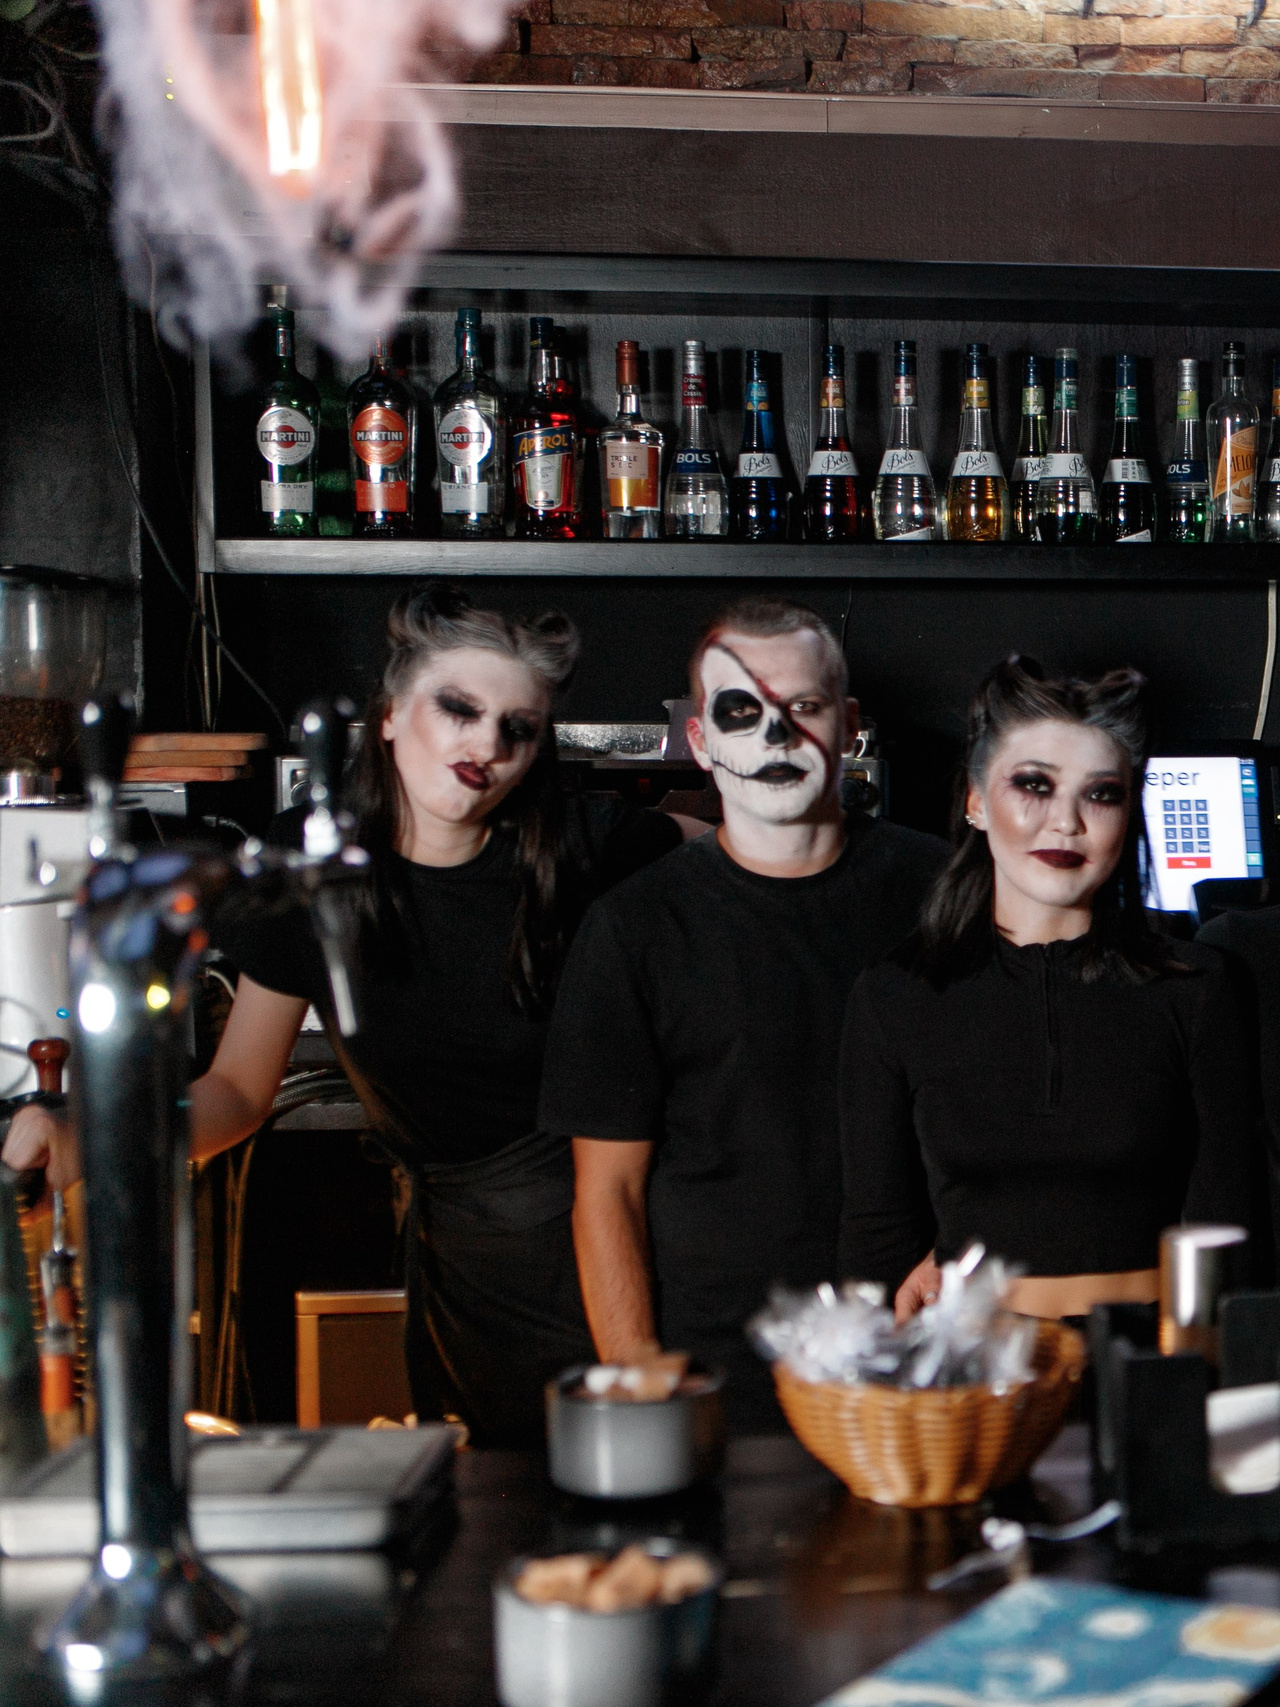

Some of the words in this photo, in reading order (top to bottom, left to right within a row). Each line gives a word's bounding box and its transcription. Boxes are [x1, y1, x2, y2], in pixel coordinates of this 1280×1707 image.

[262, 431, 310, 441] MARTINI
[356, 431, 403, 441] MARTINI
[519, 433, 568, 457] APEROL
[676, 453, 712, 464] BOLS
[743, 453, 771, 477] Bols
[821, 452, 849, 475] Bols
[887, 451, 914, 474] Bols
[960, 452, 987, 475] Bols
